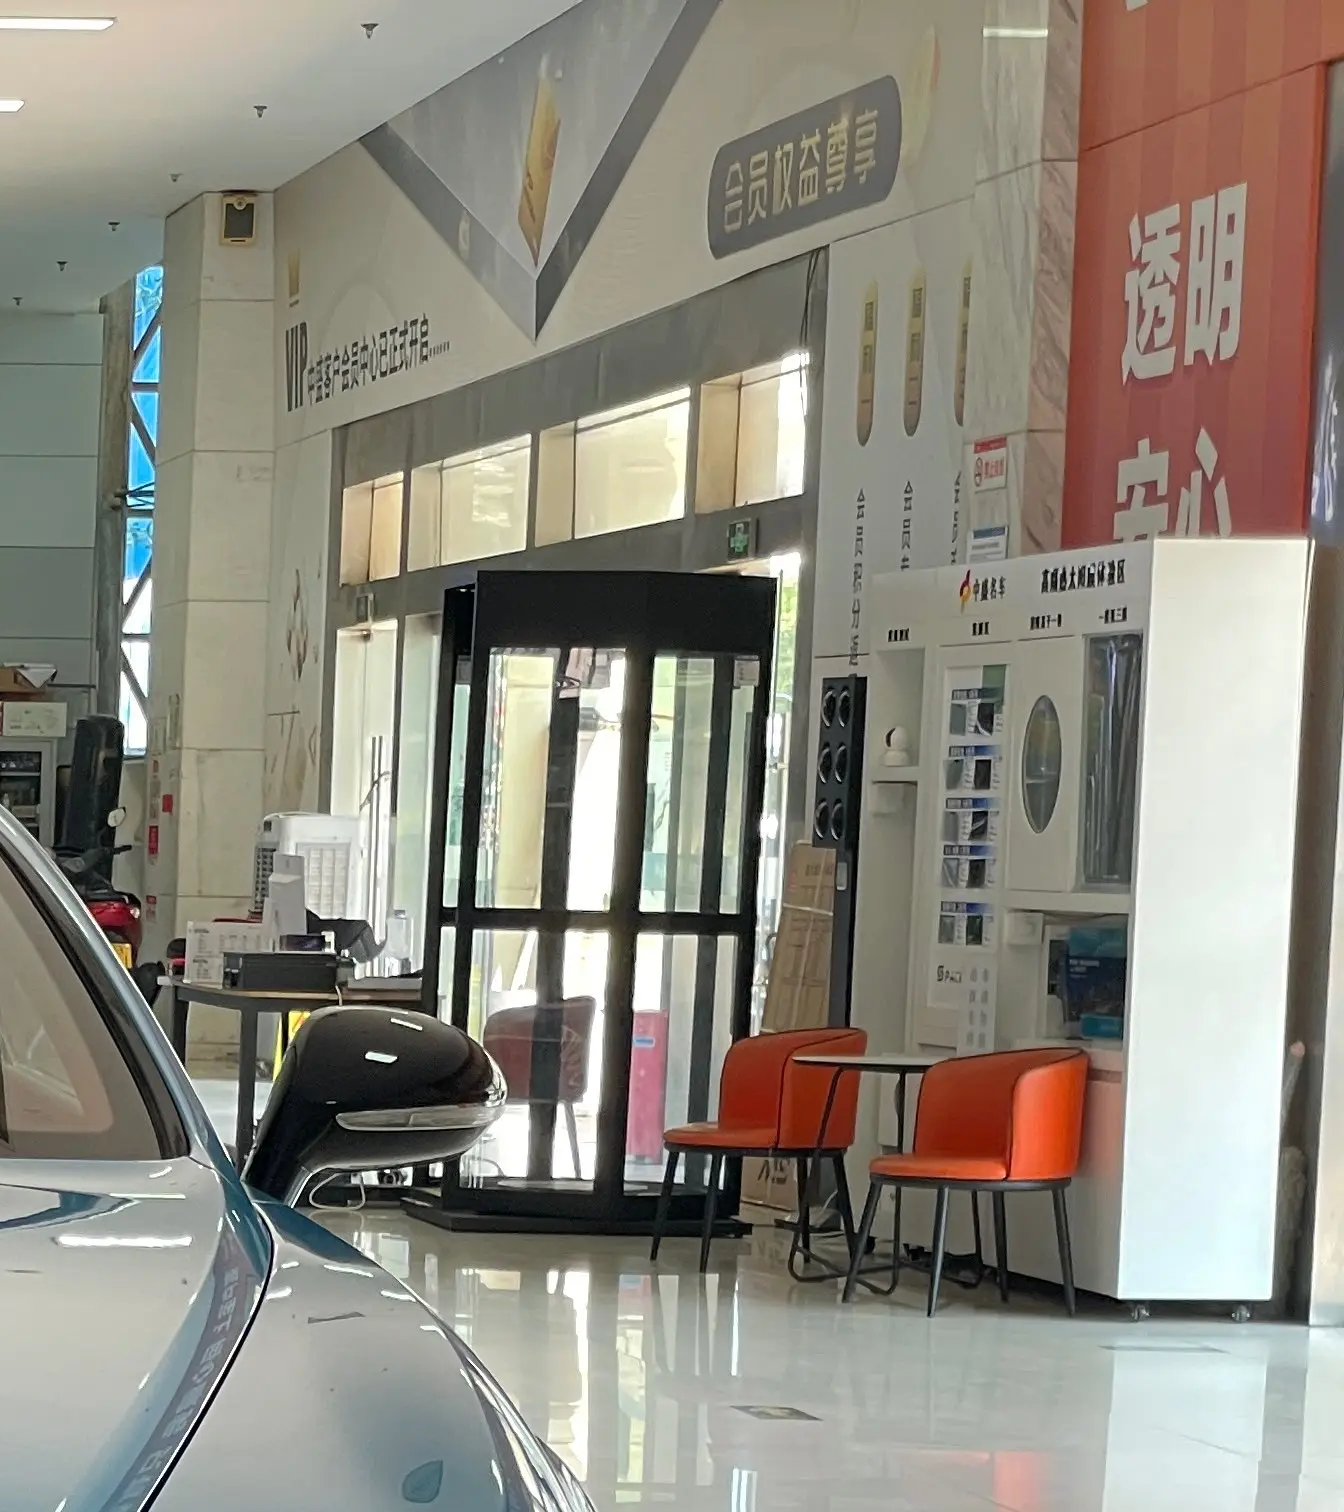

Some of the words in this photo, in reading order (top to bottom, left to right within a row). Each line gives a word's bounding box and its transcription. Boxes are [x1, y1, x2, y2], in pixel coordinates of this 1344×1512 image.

[724, 108, 878, 234] 会员权益尊享
[1122, 181, 1247, 386] 透明
[285, 321, 308, 412] VIP
[1113, 425, 1233, 541] 安心
[972, 576, 1006, 601] 中盛名车
